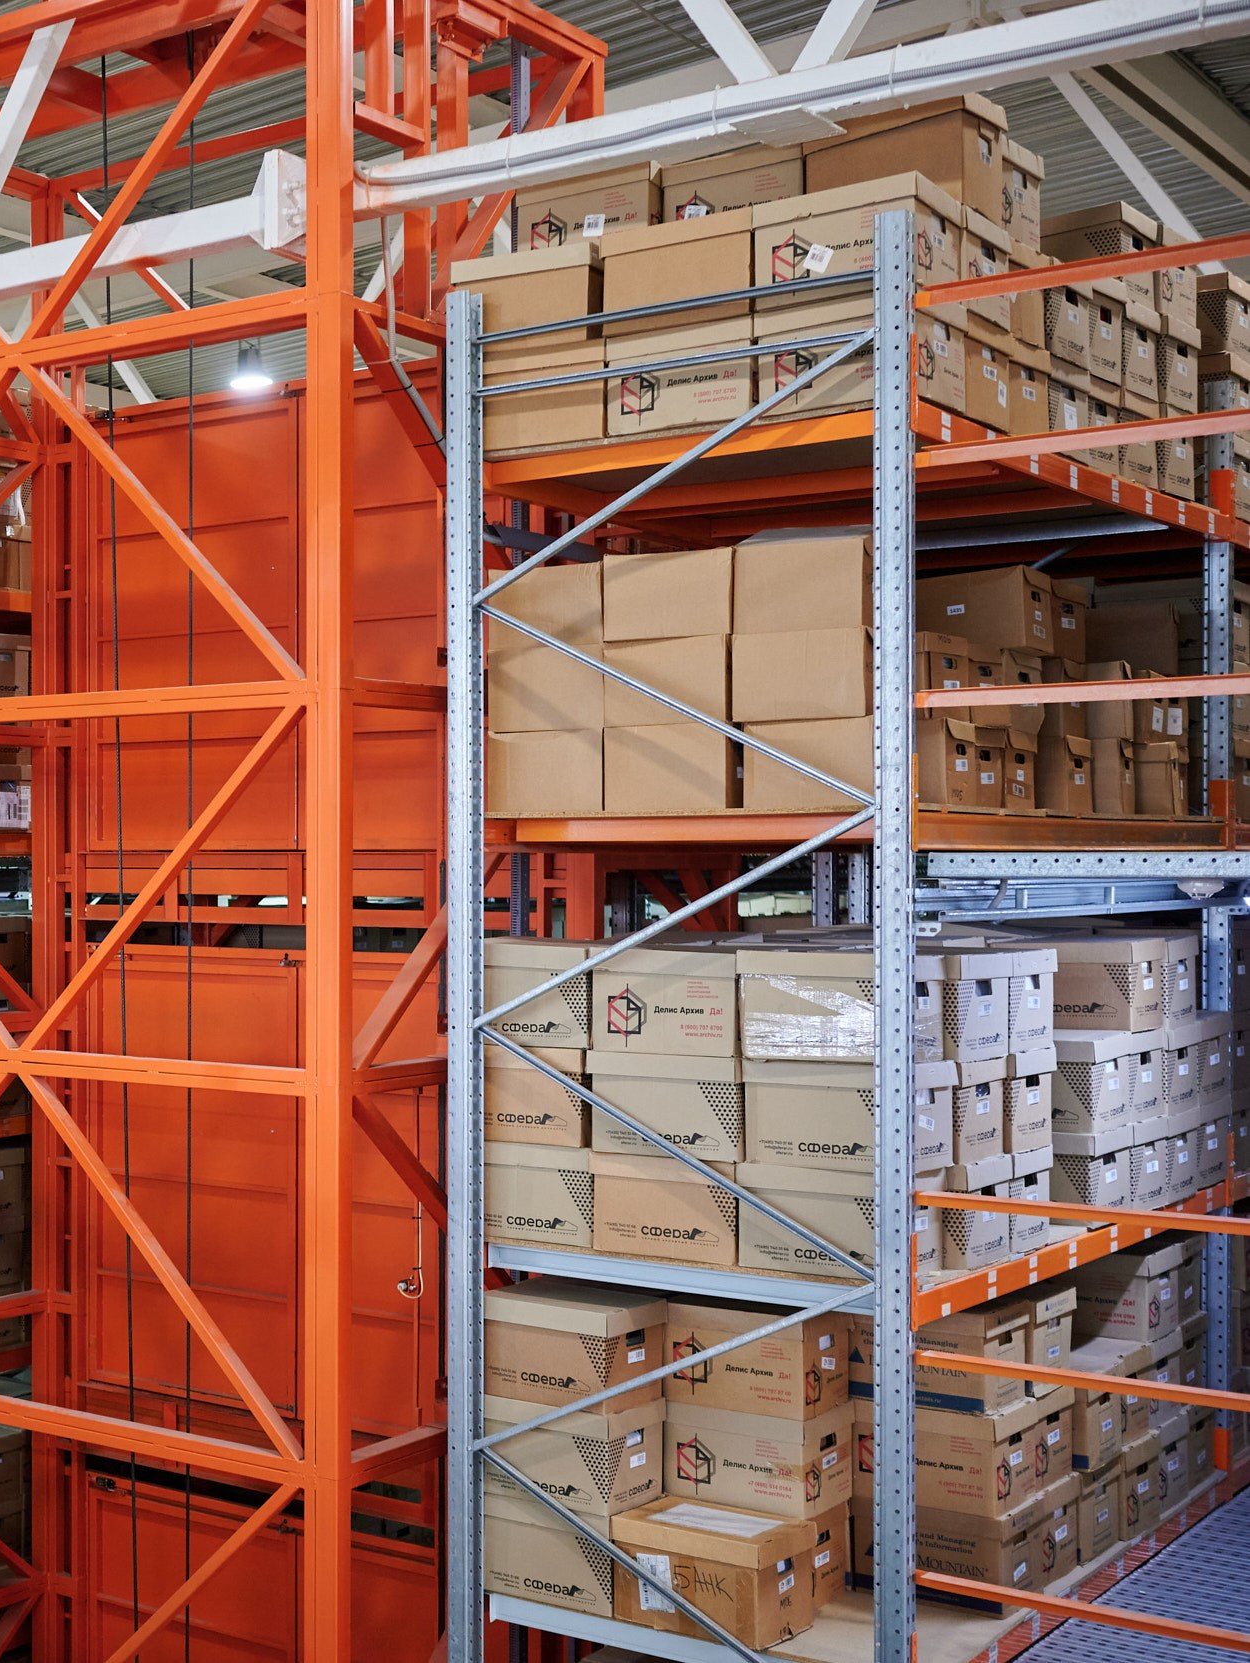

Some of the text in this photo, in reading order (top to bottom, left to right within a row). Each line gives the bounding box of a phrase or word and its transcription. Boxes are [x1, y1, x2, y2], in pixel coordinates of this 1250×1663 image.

[625, 212, 637, 221] Да!
[853, 239, 873, 248] Архи
[667, 369, 737, 387] Делис Архив Да!
[654, 1005, 723, 1016] Делис Архив Да!
[502, 1022, 546, 1033] сфера
[496, 1111, 542, 1126] сфера
[798, 1142, 850, 1155] сфера
[506, 1214, 551, 1229] сфера
[641, 1225, 690, 1239] сфера
[919, 1337, 959, 1349] Managing
[521, 1371, 564, 1387] сфера
[725, 1363, 791, 1380] Делис Архив Да!
[723, 1458, 747, 1469] Делис
[749, 1463, 773, 1474] Архив
[939, 1461, 964, 1471] Архив
[968, 1466, 982, 1475] Да!
[919, 1532, 976, 1548] and Managing
[925, 1540, 973, 1555] Information
[524, 1577, 569, 1595] сфера
[673, 1564, 734, 1602] БАНК
